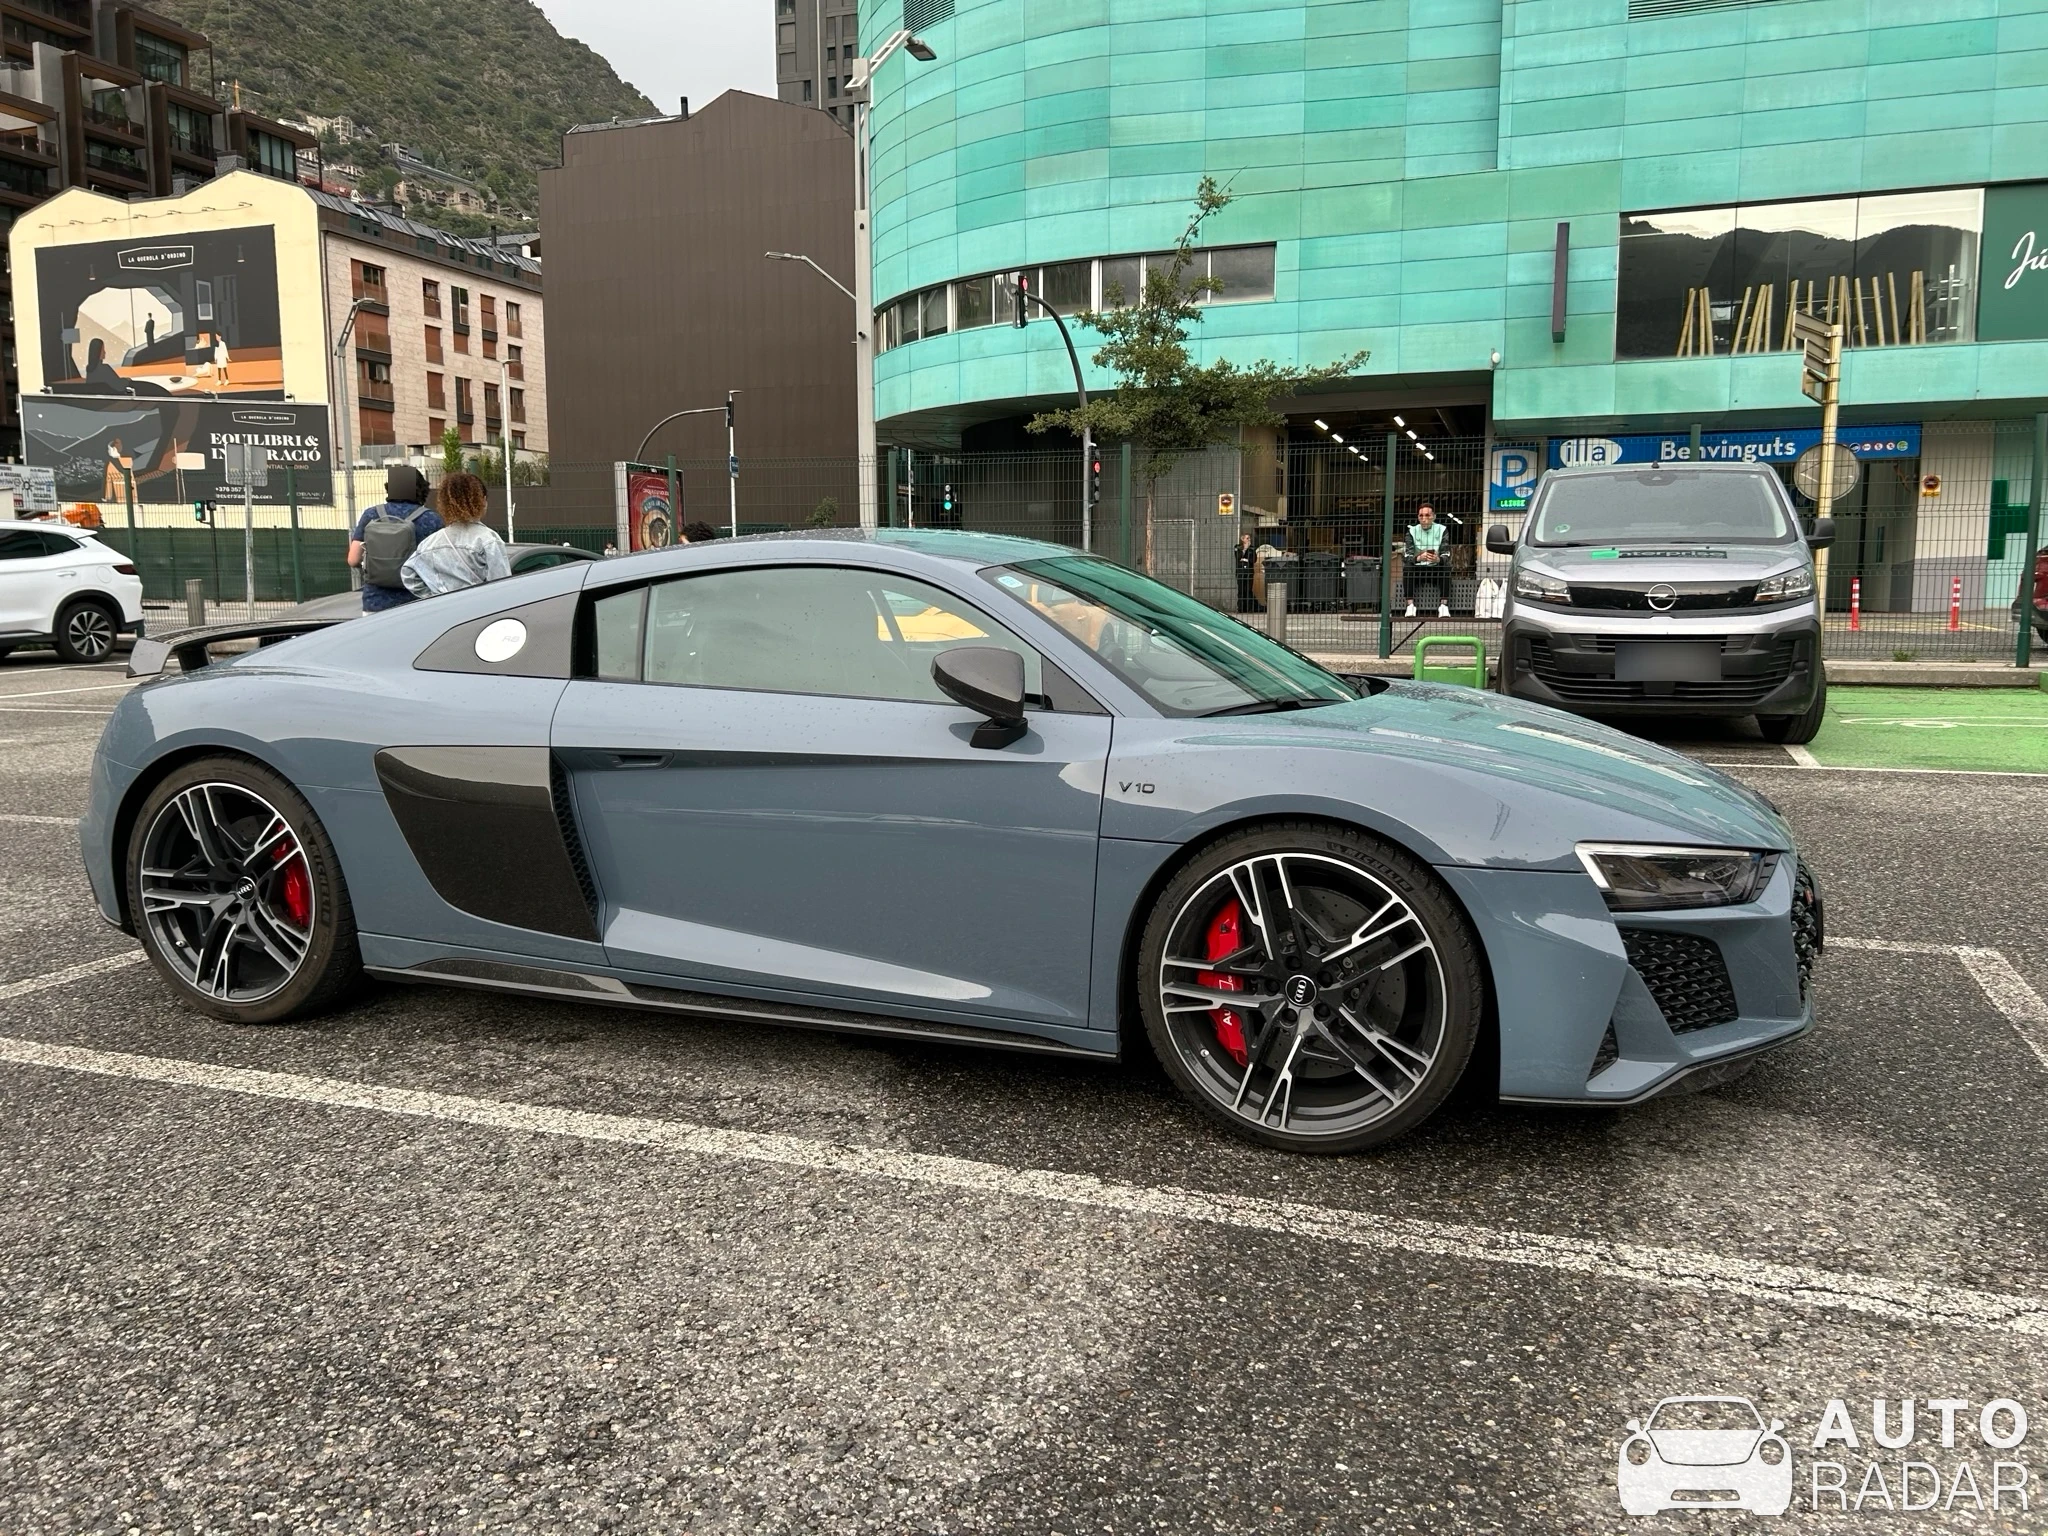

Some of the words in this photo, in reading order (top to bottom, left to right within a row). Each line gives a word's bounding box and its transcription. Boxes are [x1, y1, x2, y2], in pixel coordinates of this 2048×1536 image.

[137, 254, 159, 262] QUEROLA
[160, 252, 186, 260] D'ORDINO
[210, 433, 302, 447] EQUILIBRI
[304, 435, 320, 447] &
[1566, 437, 1606, 462] illa
[211, 447, 321, 461] INRACIÓ
[1660, 437, 1796, 463] Benvinguts
[1501, 454, 1529, 488] P
[1119, 781, 1155, 794] V10
[1342, 846, 1414, 892] MICHELIN
